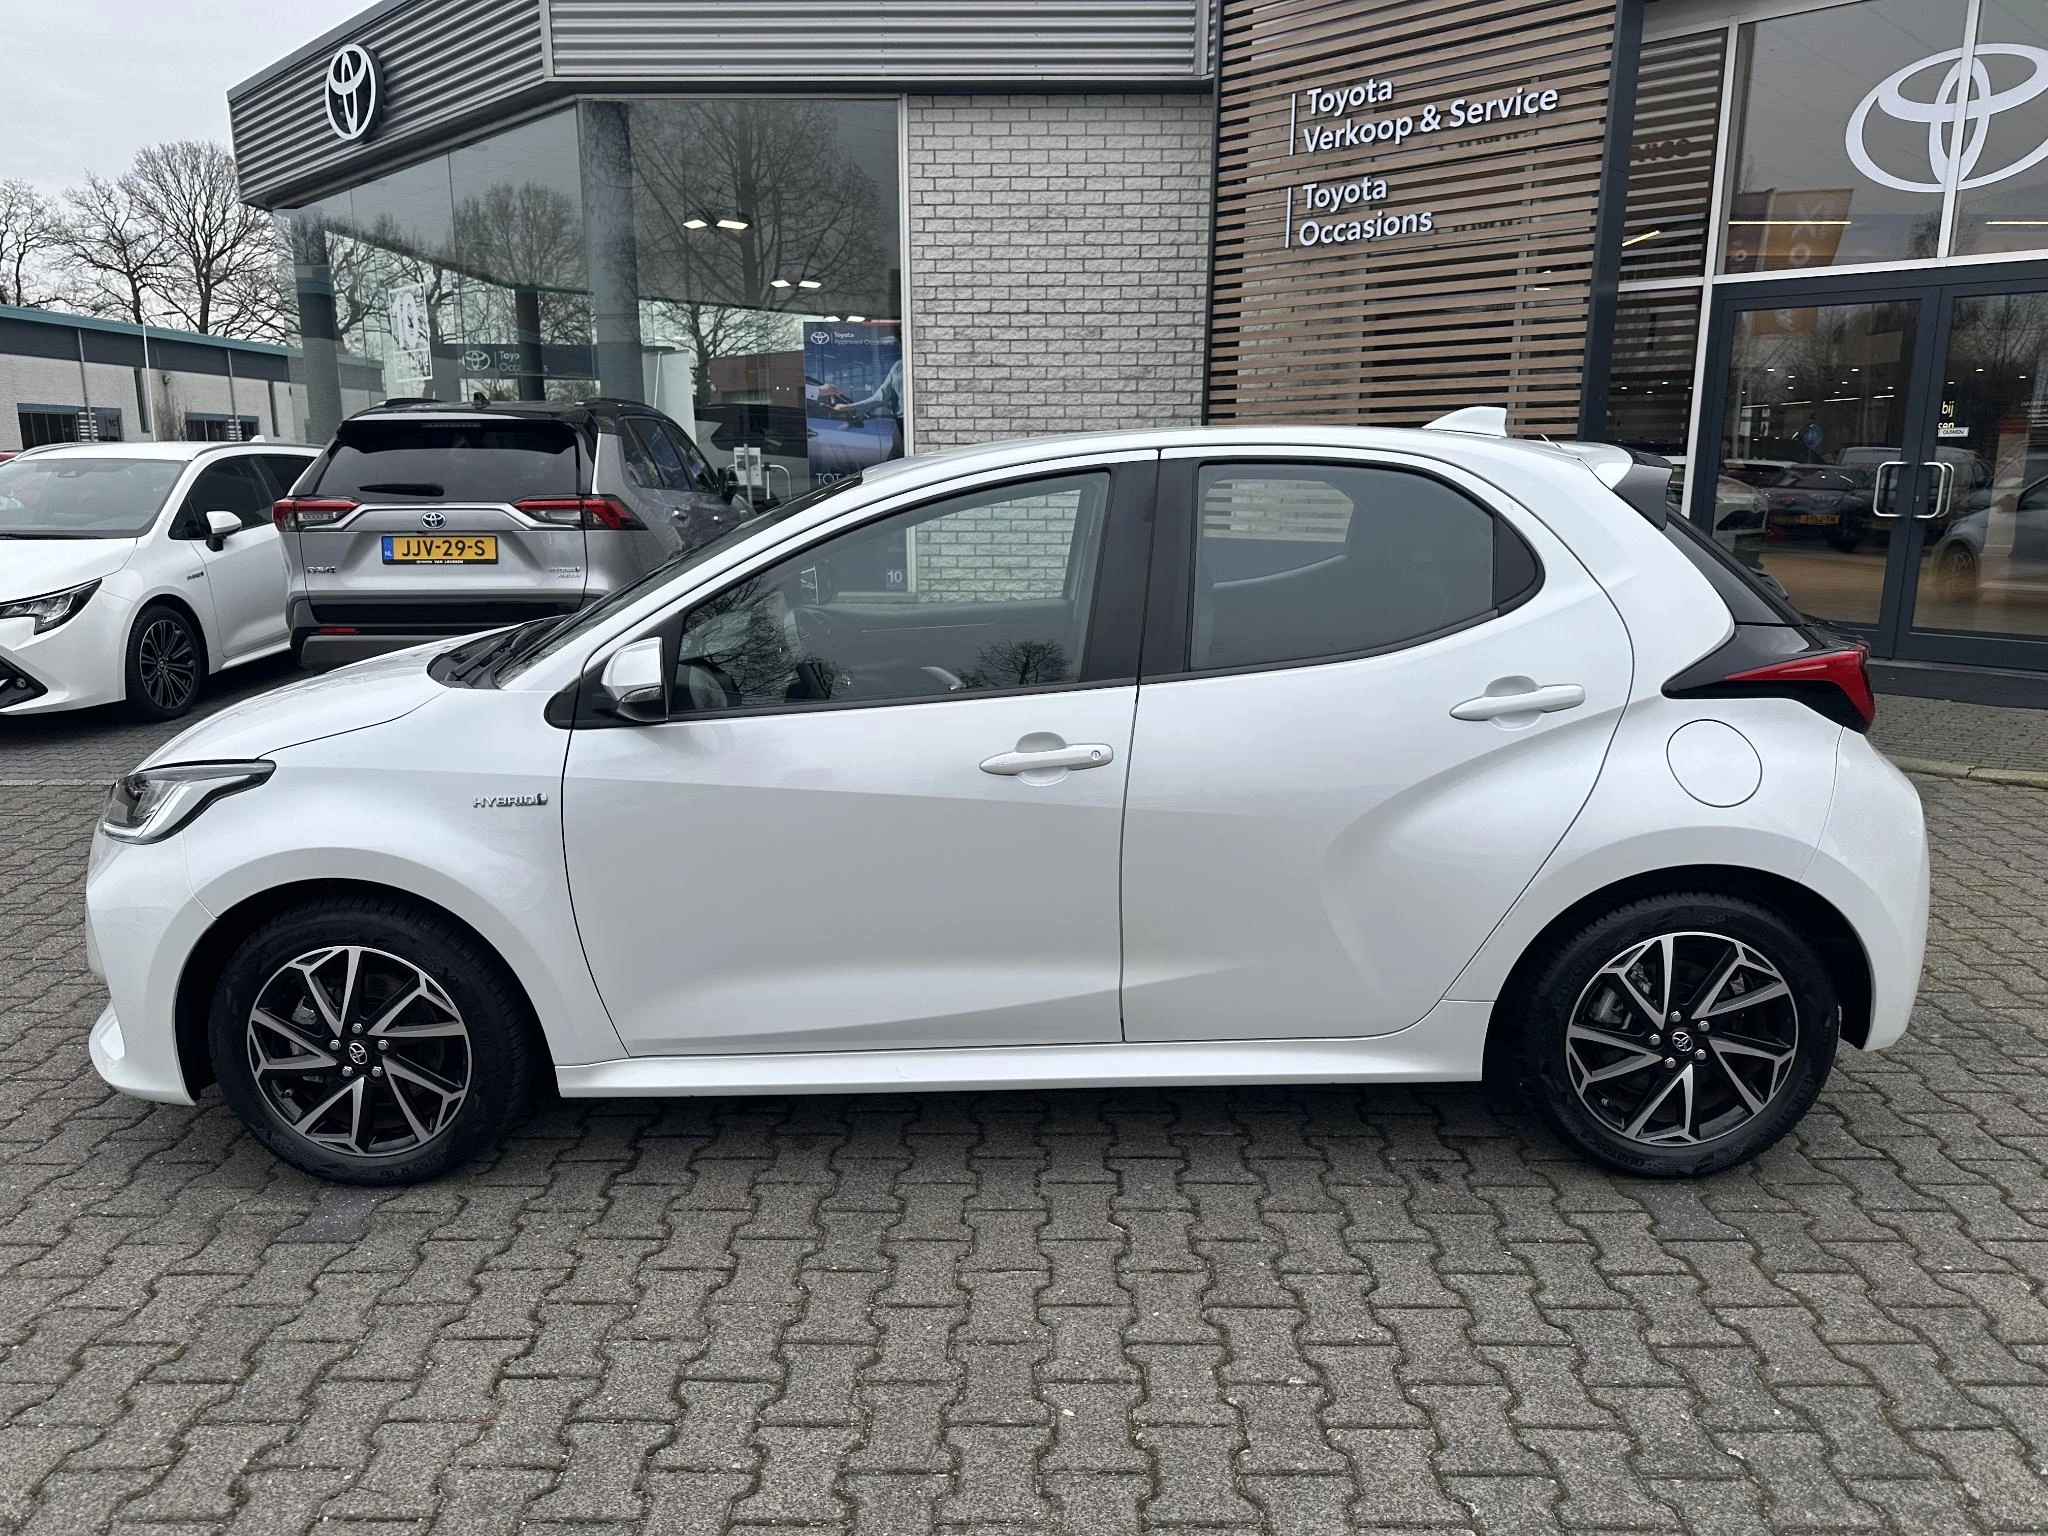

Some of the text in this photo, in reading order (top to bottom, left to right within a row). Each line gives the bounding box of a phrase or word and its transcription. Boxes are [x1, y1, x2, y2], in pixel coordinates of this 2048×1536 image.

[1306, 78, 1393, 117] Toyota
[1302, 115, 1413, 153] Verkoop
[1420, 104, 1442, 132] &
[1450, 86, 1559, 128] Service
[1302, 175, 1388, 213] Toyota
[1299, 209, 1433, 247] Occasions
[1941, 401, 1955, 417] bij
[401, 539, 486, 557] JJV-29-S
[887, 570, 903, 583] 10
[473, 795, 536, 808] HYBRID
